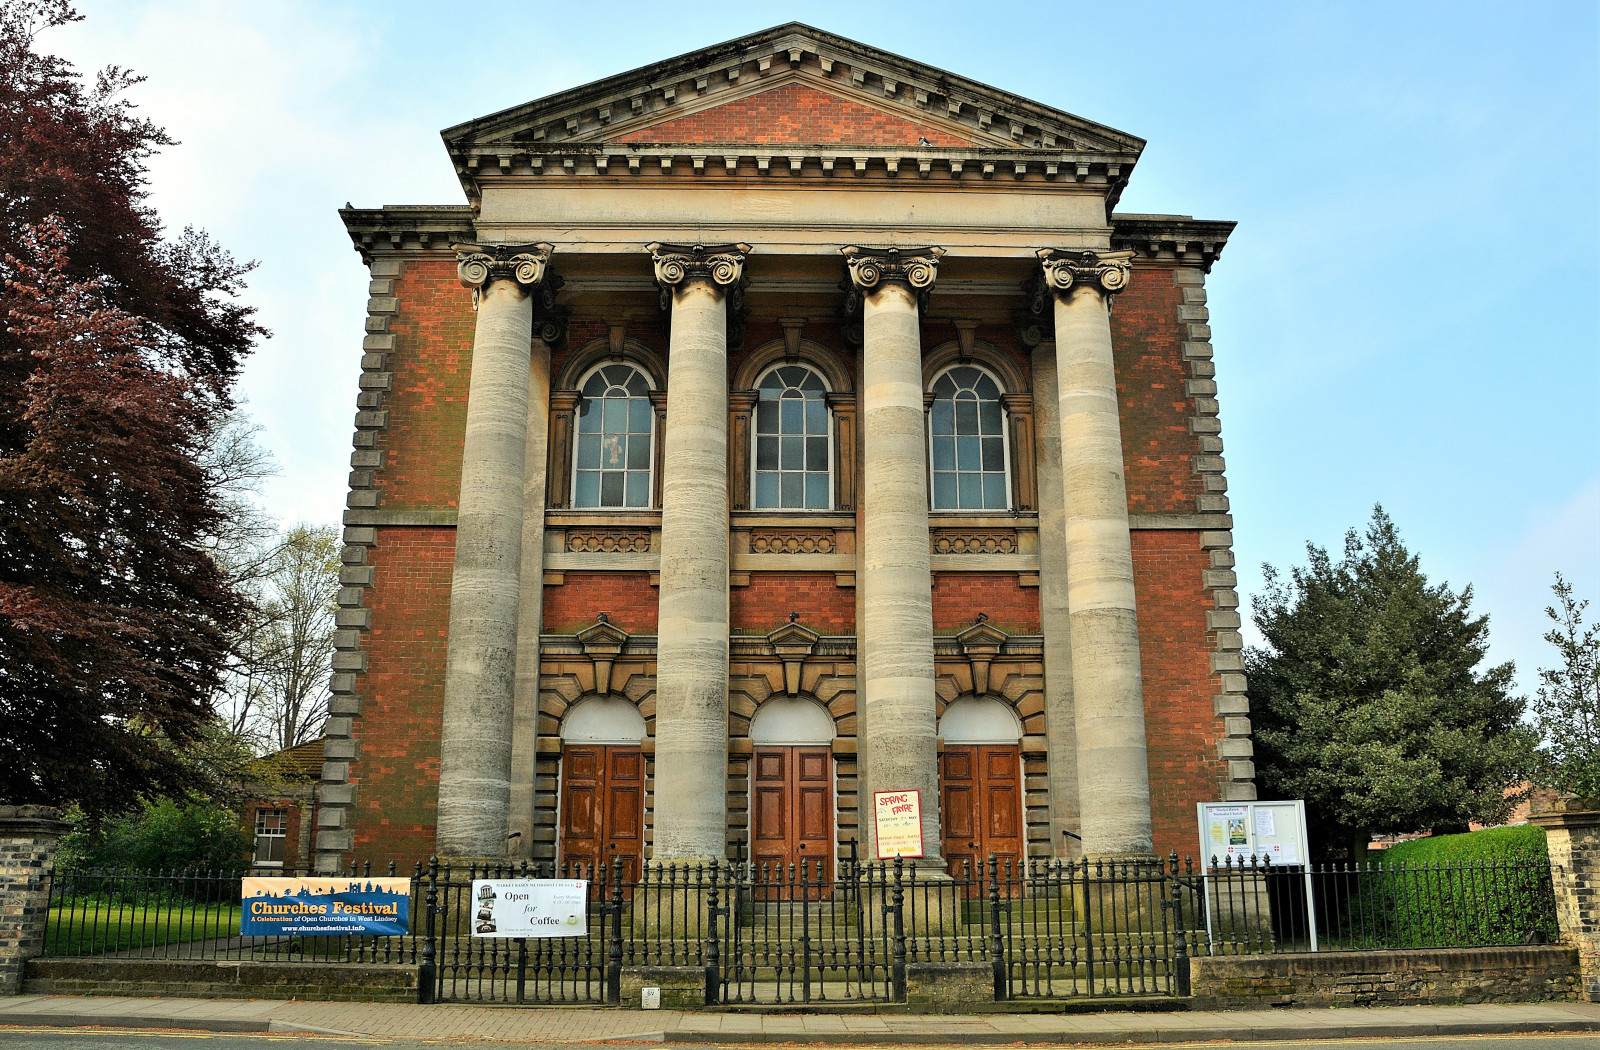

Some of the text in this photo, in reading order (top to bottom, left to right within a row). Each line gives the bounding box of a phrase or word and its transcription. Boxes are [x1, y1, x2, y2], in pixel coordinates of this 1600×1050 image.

[880, 794, 908, 806] SPRING
[892, 804, 913, 815] FAYRE
[504, 892, 529, 902] Open
[251, 902, 398, 914] Churches Festival
[522, 904, 538, 914] for
[530, 916, 560, 925] Coffee
